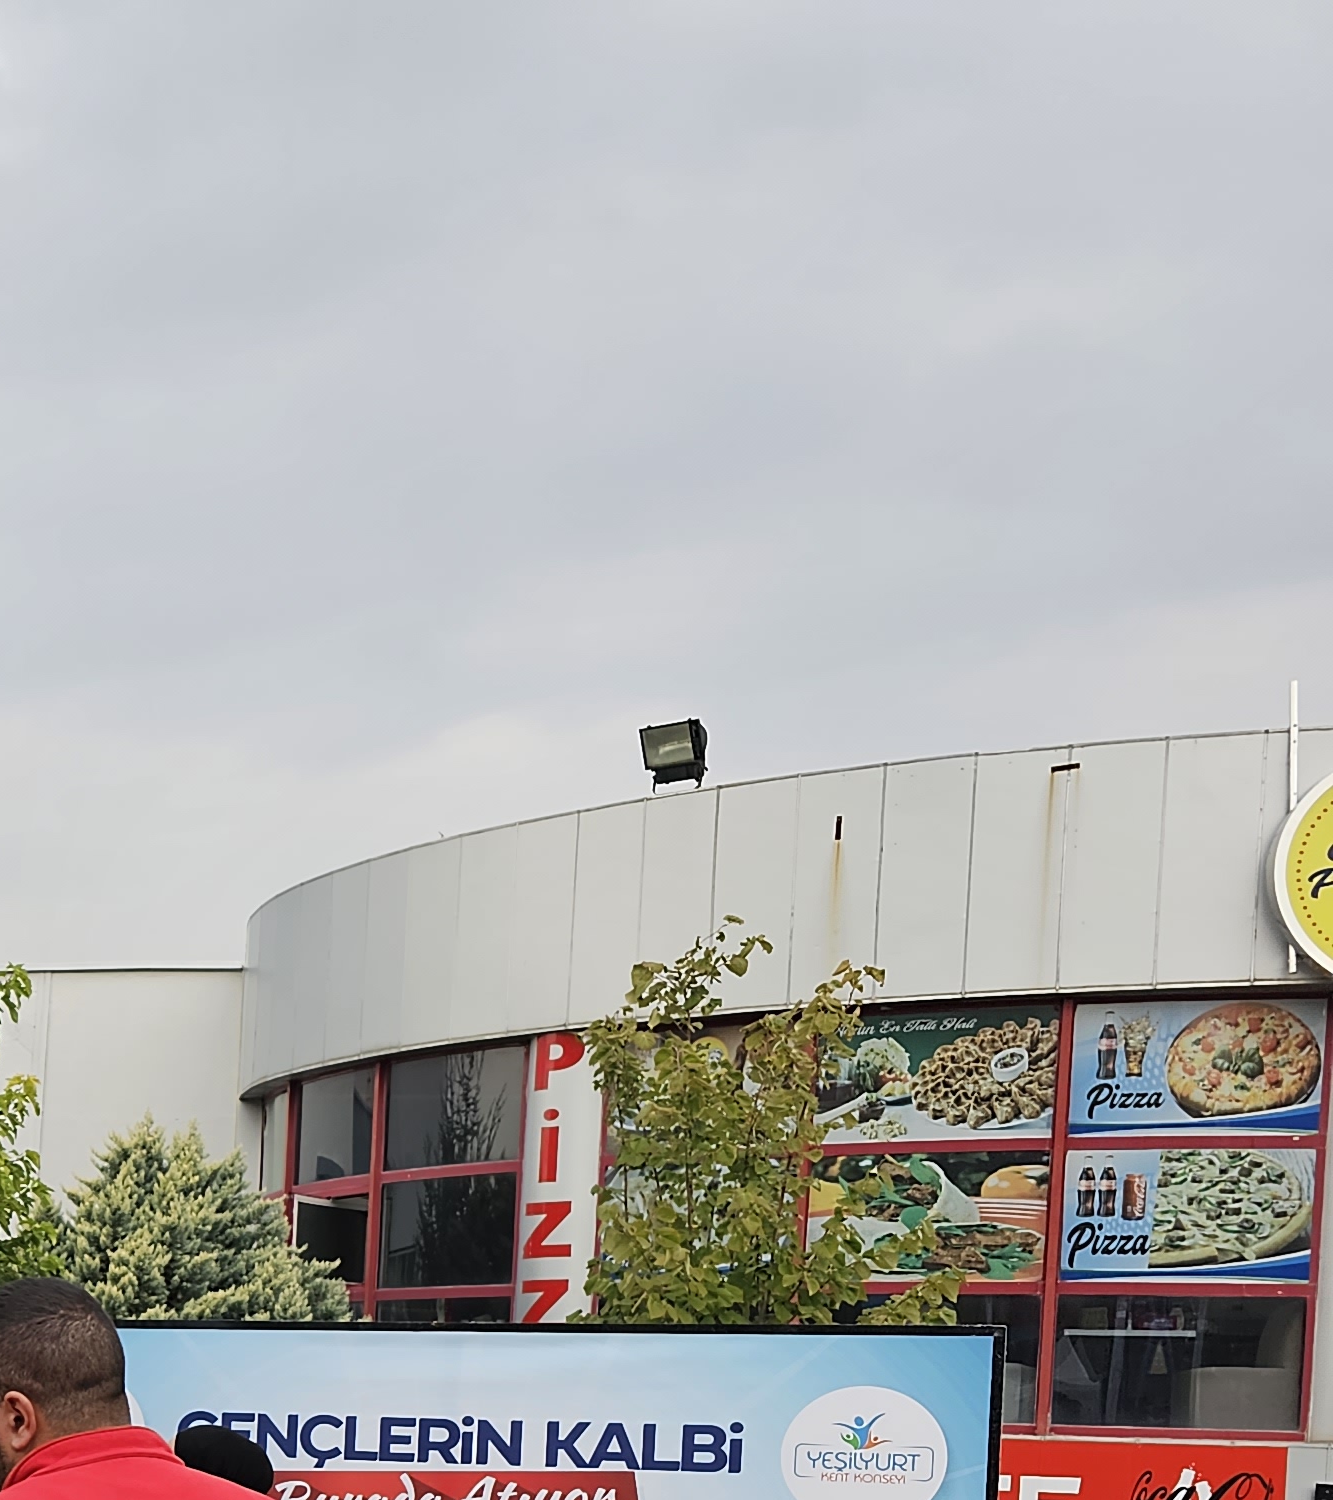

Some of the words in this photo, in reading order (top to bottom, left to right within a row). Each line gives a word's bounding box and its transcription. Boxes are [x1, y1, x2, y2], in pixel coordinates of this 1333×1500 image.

[1087, 1083, 1165, 1119] Pizza
[1067, 1222, 1151, 1268] Pizza
[807, 1451, 921, 1473] YEŞİLYURT
